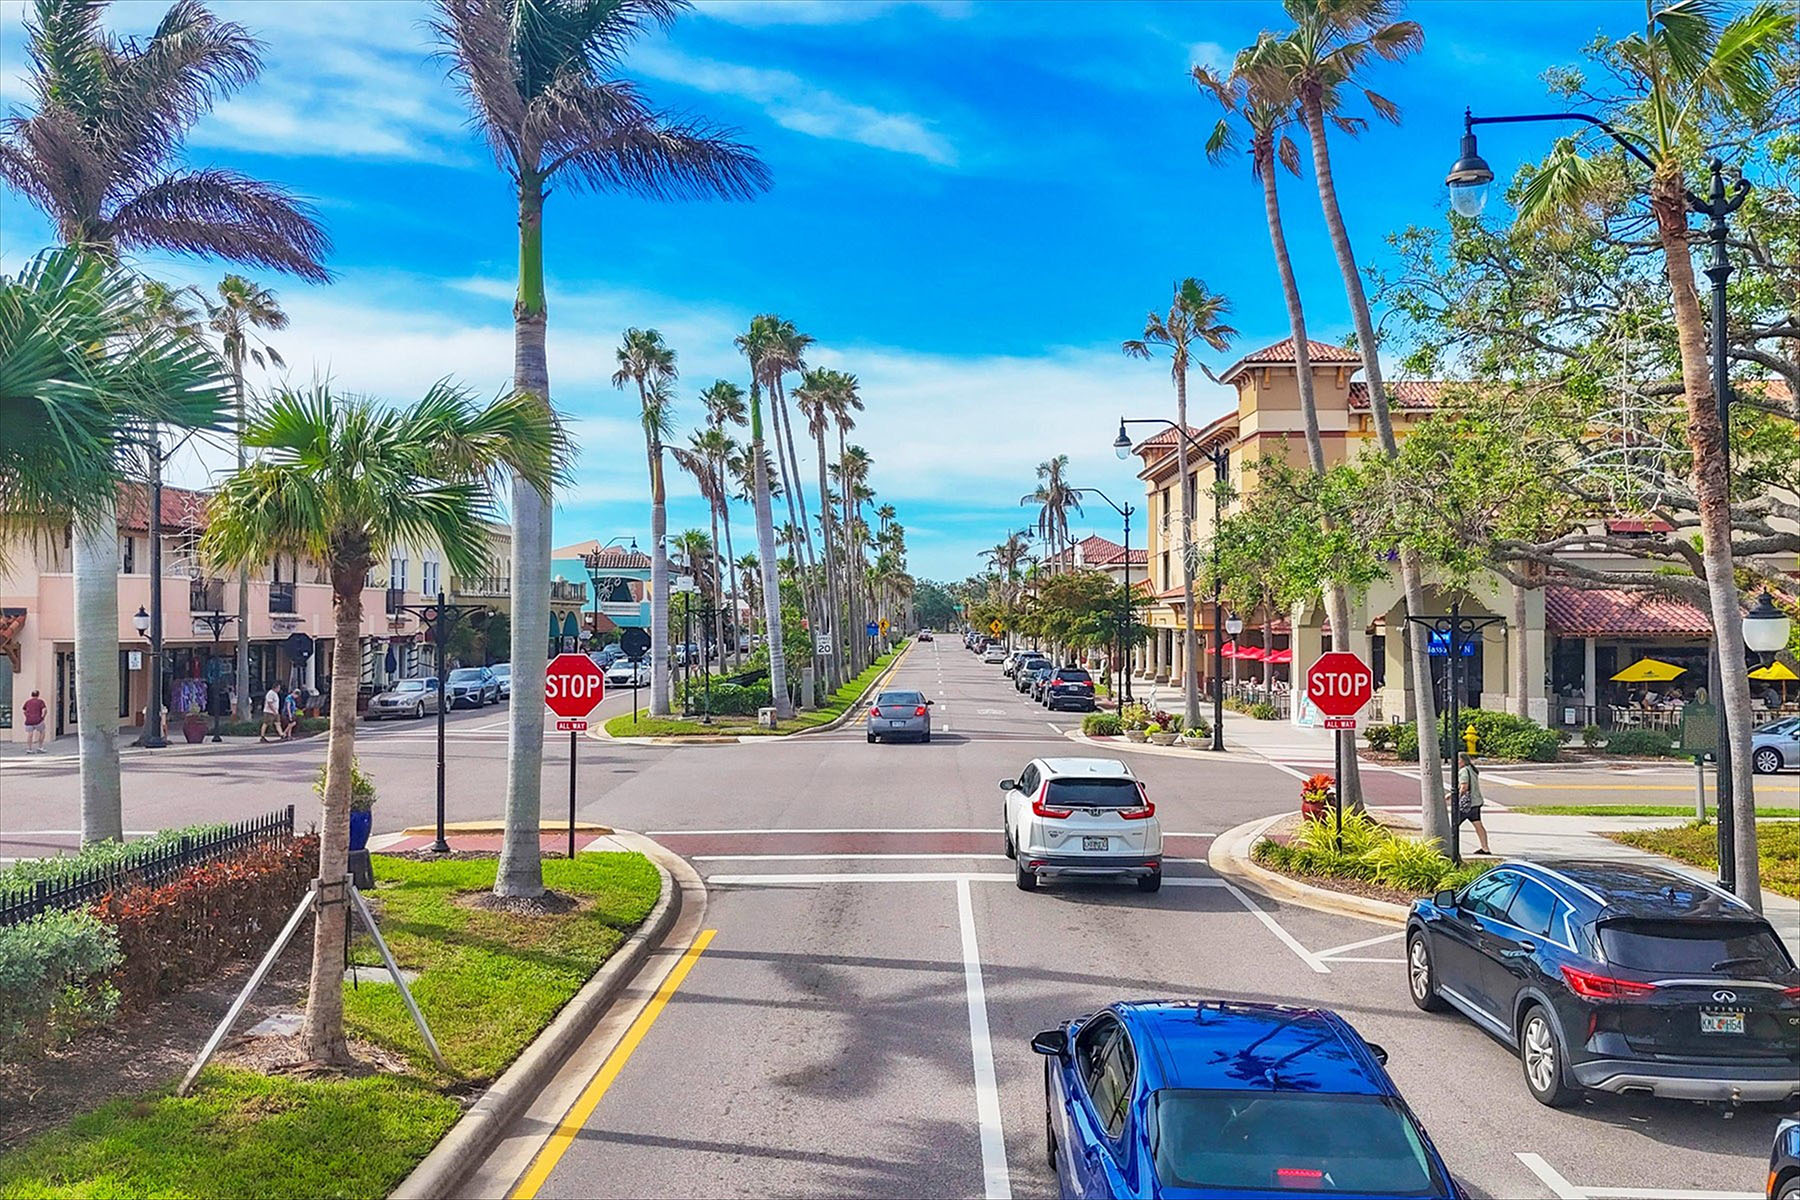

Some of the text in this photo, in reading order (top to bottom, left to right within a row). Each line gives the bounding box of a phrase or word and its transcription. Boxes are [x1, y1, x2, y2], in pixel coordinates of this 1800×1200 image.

[818, 644, 831, 653] 20
[545, 674, 600, 698] STOP
[1311, 672, 1368, 697] STOP
